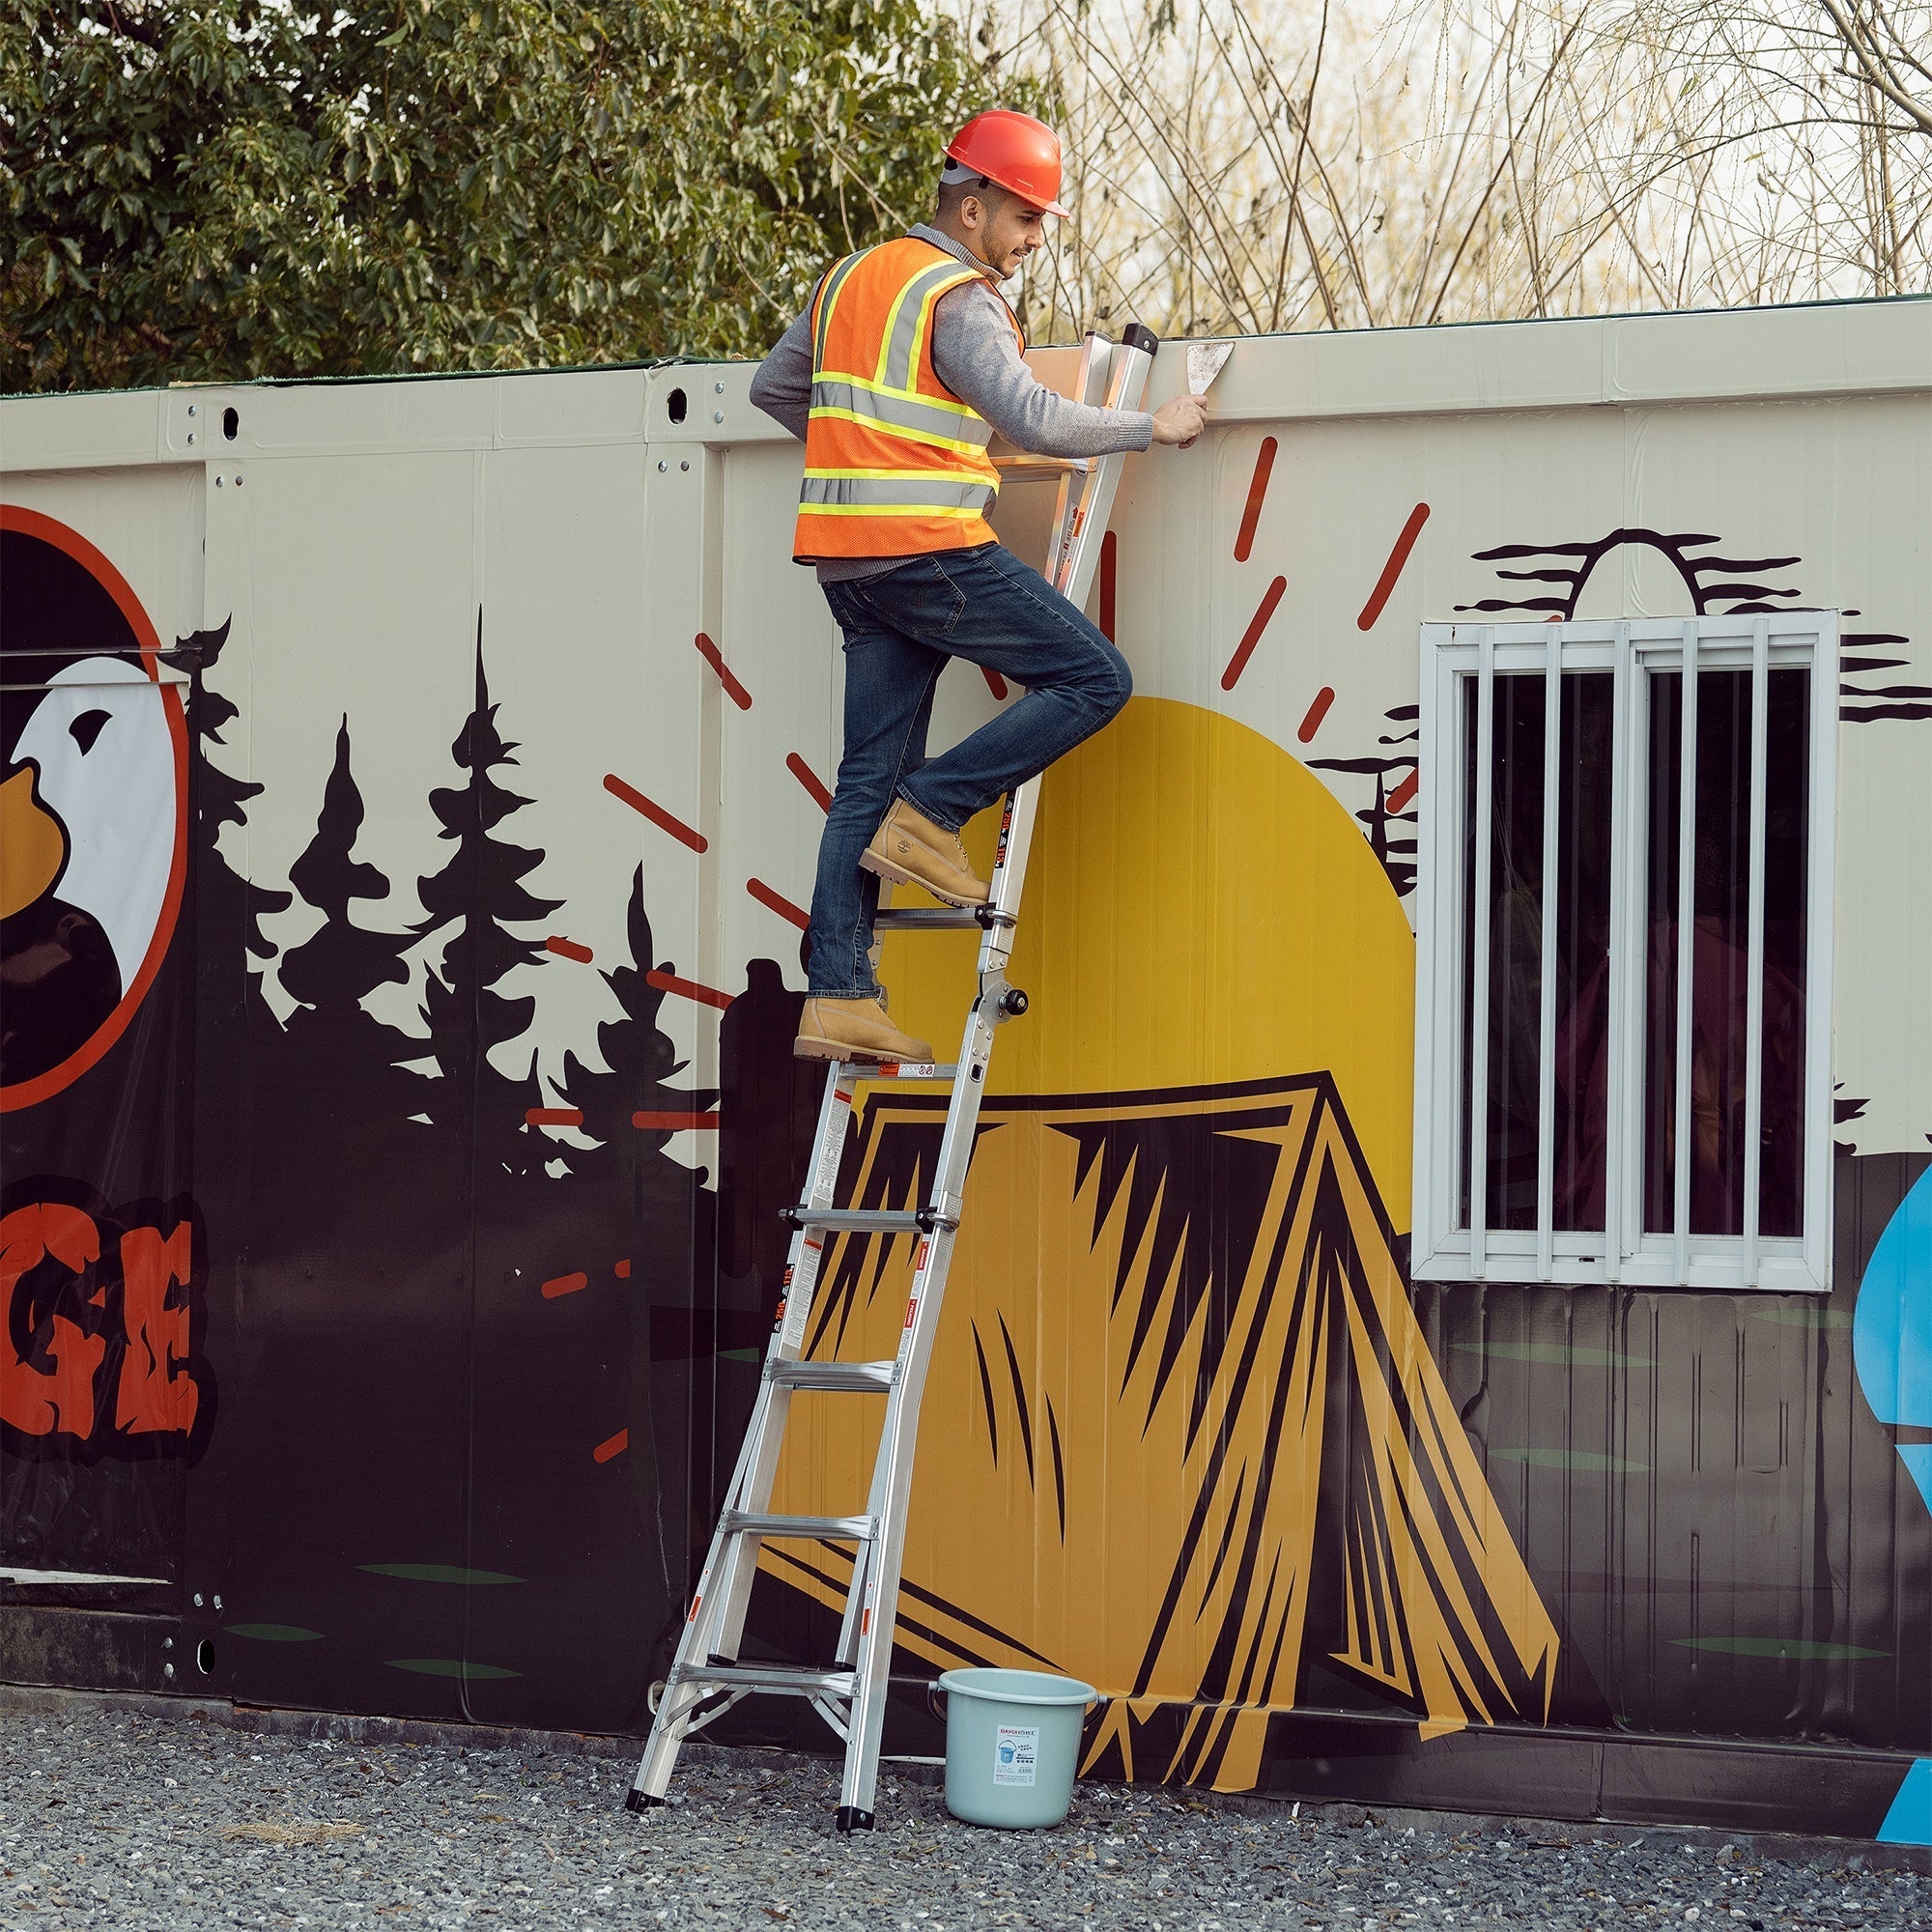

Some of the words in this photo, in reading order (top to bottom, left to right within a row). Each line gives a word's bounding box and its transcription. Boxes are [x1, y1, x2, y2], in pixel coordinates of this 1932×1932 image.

[1002, 812, 1011, 830] 250
[996, 847, 1006, 864] 113
[776, 1301, 785, 1320] 250
[783, 1269, 793, 1286] 113
